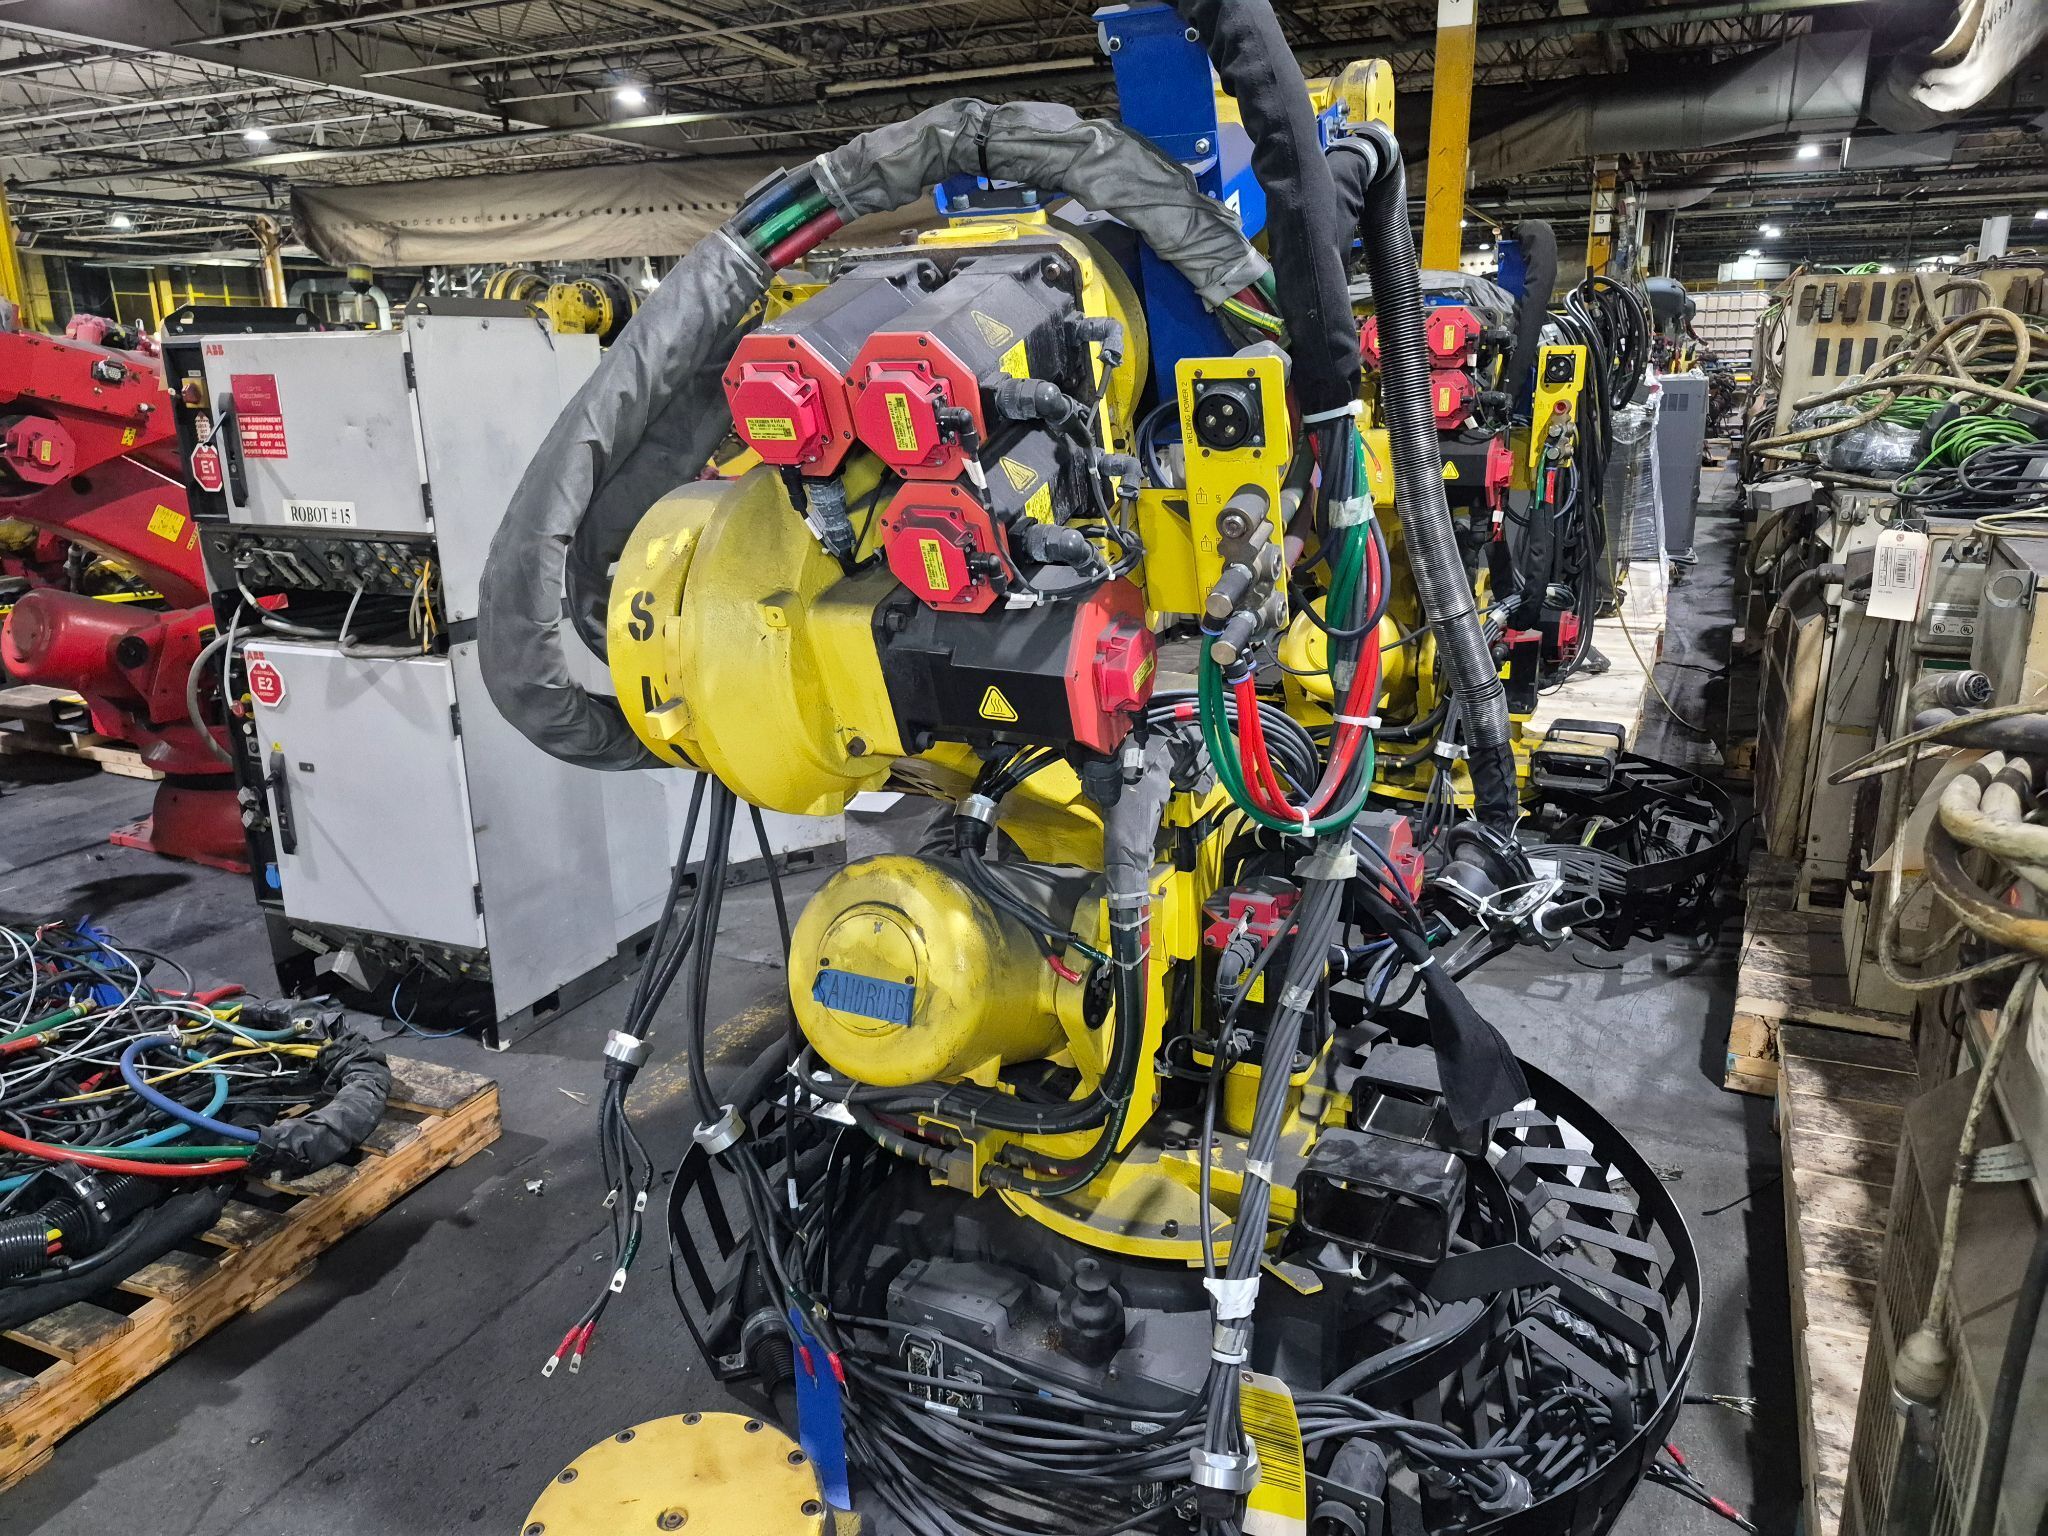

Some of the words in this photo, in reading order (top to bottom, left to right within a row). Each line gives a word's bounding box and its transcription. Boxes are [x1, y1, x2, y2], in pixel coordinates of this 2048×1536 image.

[206, 344, 224, 356] ABB
[1182, 389, 1191, 413] POWER
[1185, 414, 1194, 445] WELDING
[201, 460, 215, 474] E1
[290, 505, 329, 523] ROBOT
[340, 508, 351, 524] 15
[627, 590, 656, 642] S
[247, 650, 265, 660] ABB
[258, 677, 273, 690] E2
